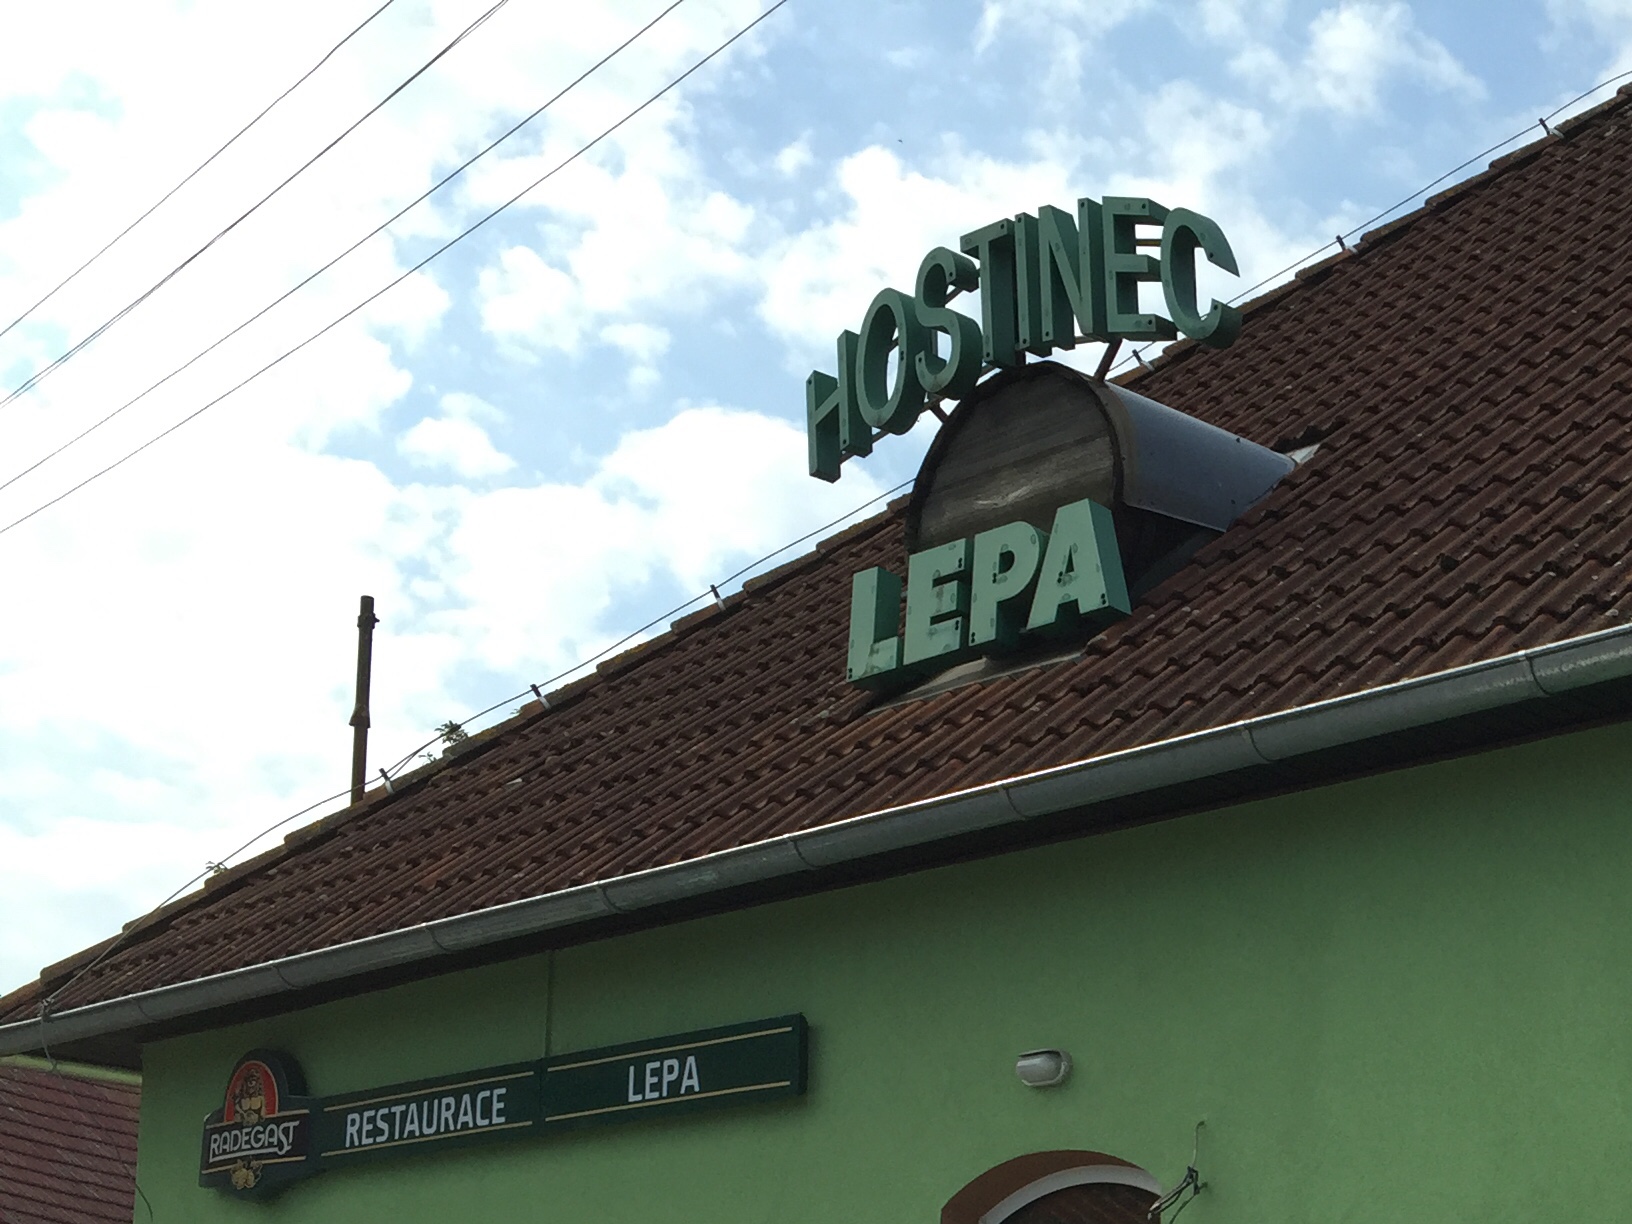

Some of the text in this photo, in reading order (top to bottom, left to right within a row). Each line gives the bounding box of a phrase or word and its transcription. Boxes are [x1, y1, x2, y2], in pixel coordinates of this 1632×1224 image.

[806, 195, 1243, 483] HOSTINEC
[846, 498, 1131, 690] LEPA
[209, 1120, 300, 1163] RADEGAST
[345, 1055, 700, 1148] RESTAURACE LEPA
